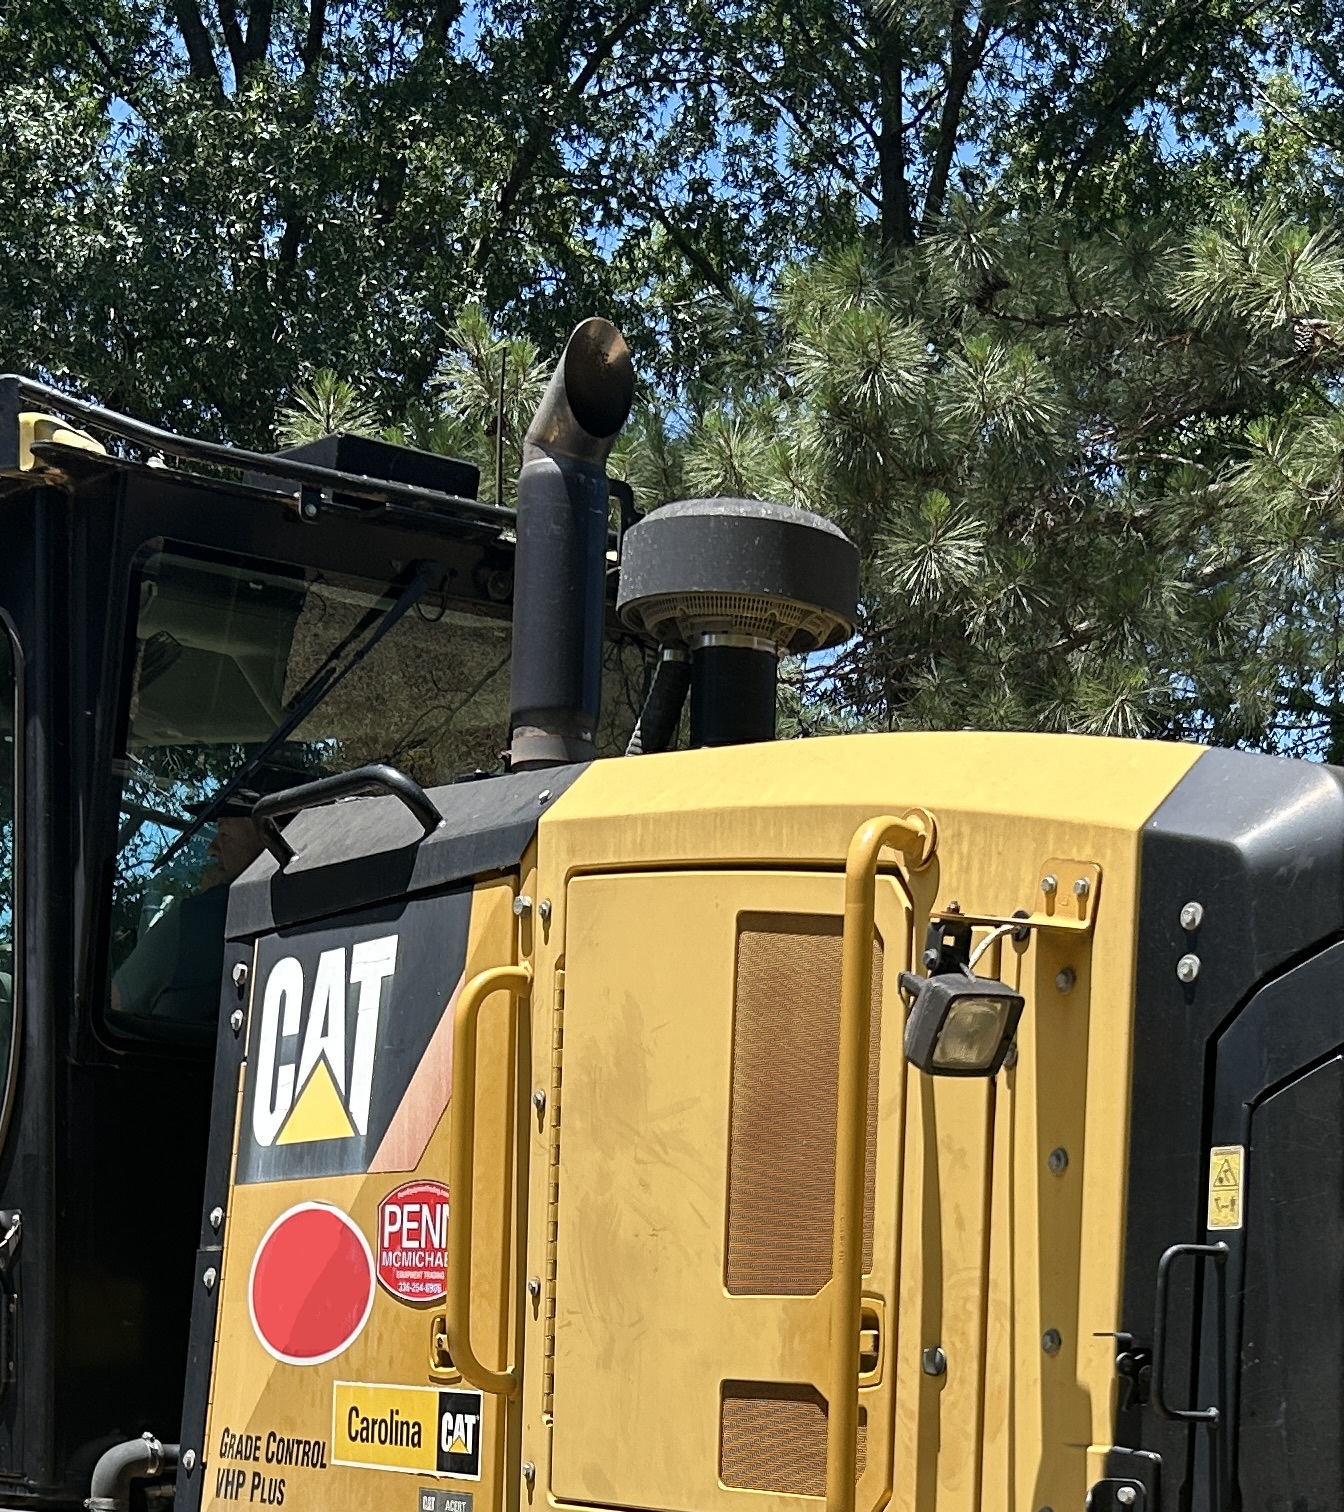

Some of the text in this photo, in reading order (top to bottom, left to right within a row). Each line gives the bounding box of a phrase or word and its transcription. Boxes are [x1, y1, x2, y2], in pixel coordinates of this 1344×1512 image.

[253, 934, 399, 1147] CAT
[219, 1426, 327, 1469] GRADE CONTROL
[347, 1405, 477, 1455] Carolina CAT
[215, 1467, 286, 1505] VHP PLUS
